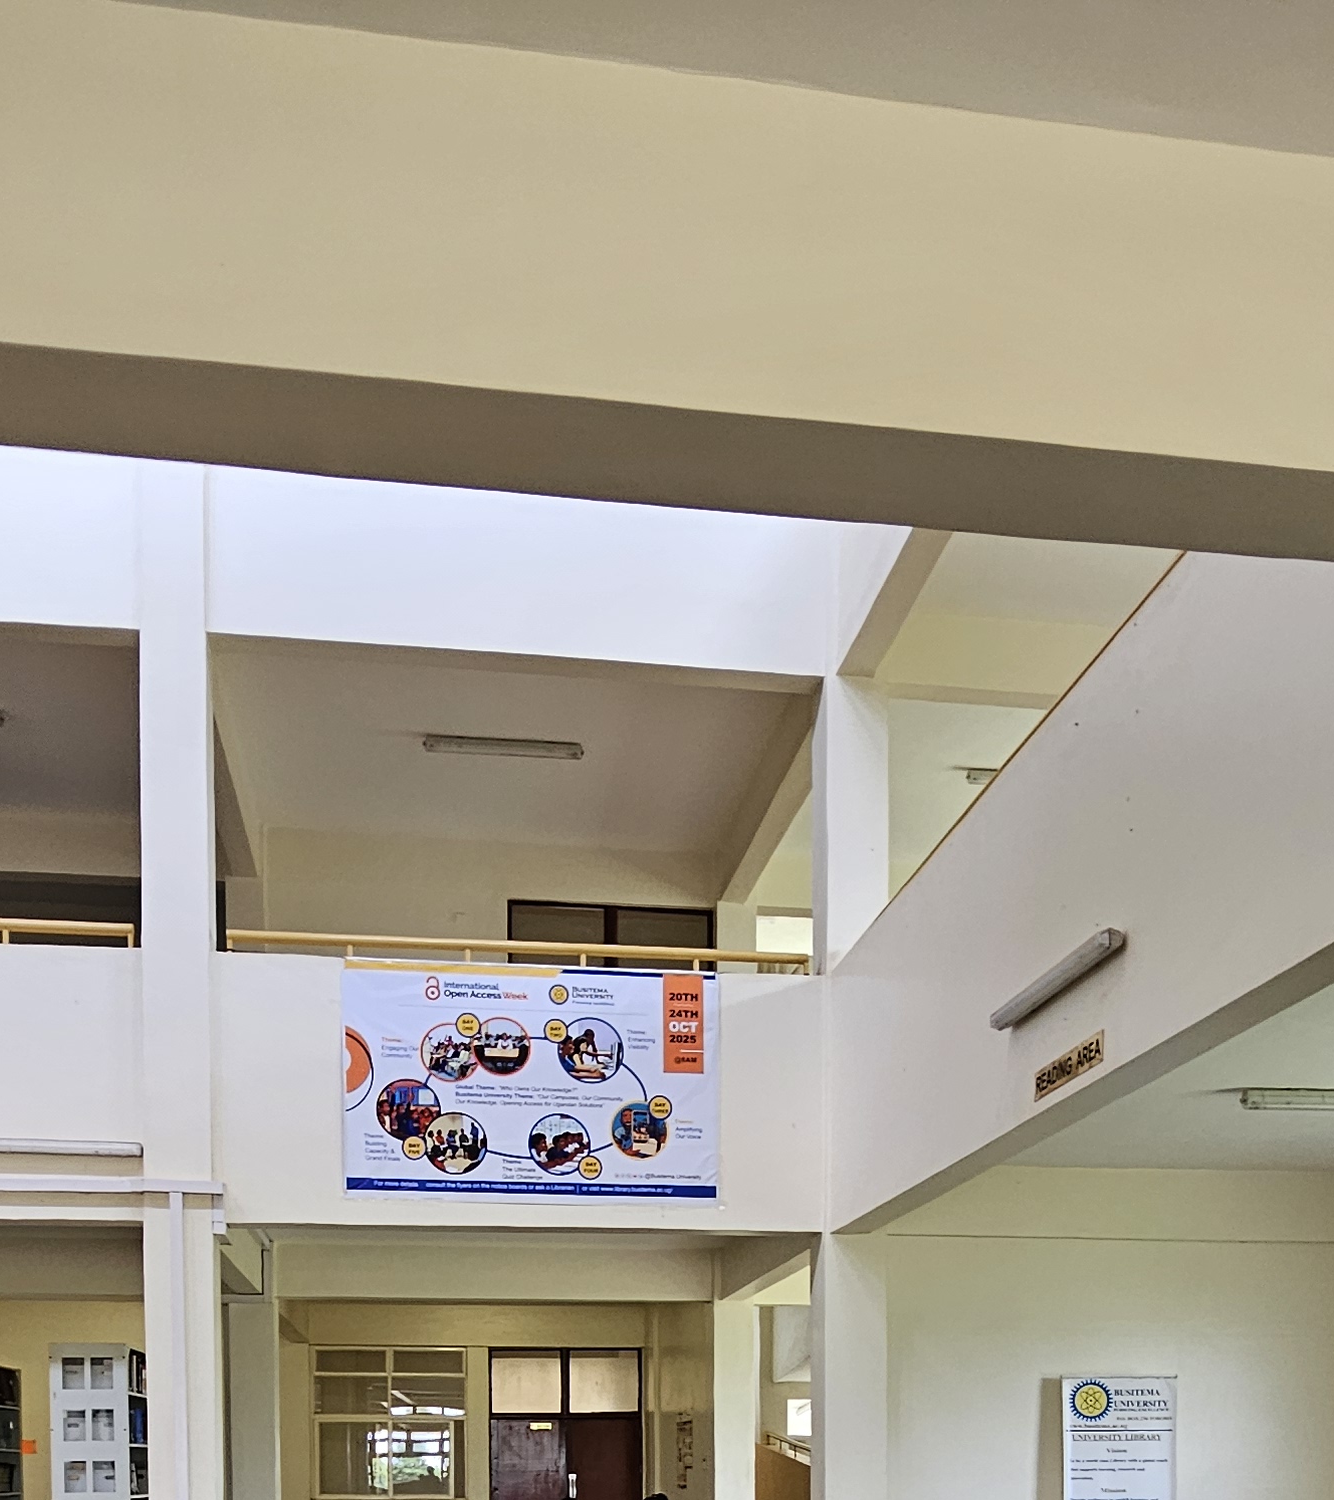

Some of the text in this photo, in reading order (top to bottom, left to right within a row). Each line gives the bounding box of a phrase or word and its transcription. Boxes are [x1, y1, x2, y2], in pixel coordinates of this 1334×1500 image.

[444, 981, 499, 990] International
[444, 990, 528, 1000] Open Access Week
[669, 993, 698, 1001] 20TH
[669, 1009, 698, 1018] 24TH
[668, 1021, 699, 1033] OCT
[669, 1035, 697, 1043] 2025
[1036, 1038, 1102, 1095] READING AREA
[1114, 1400, 1169, 1408] UNIVERSITY
